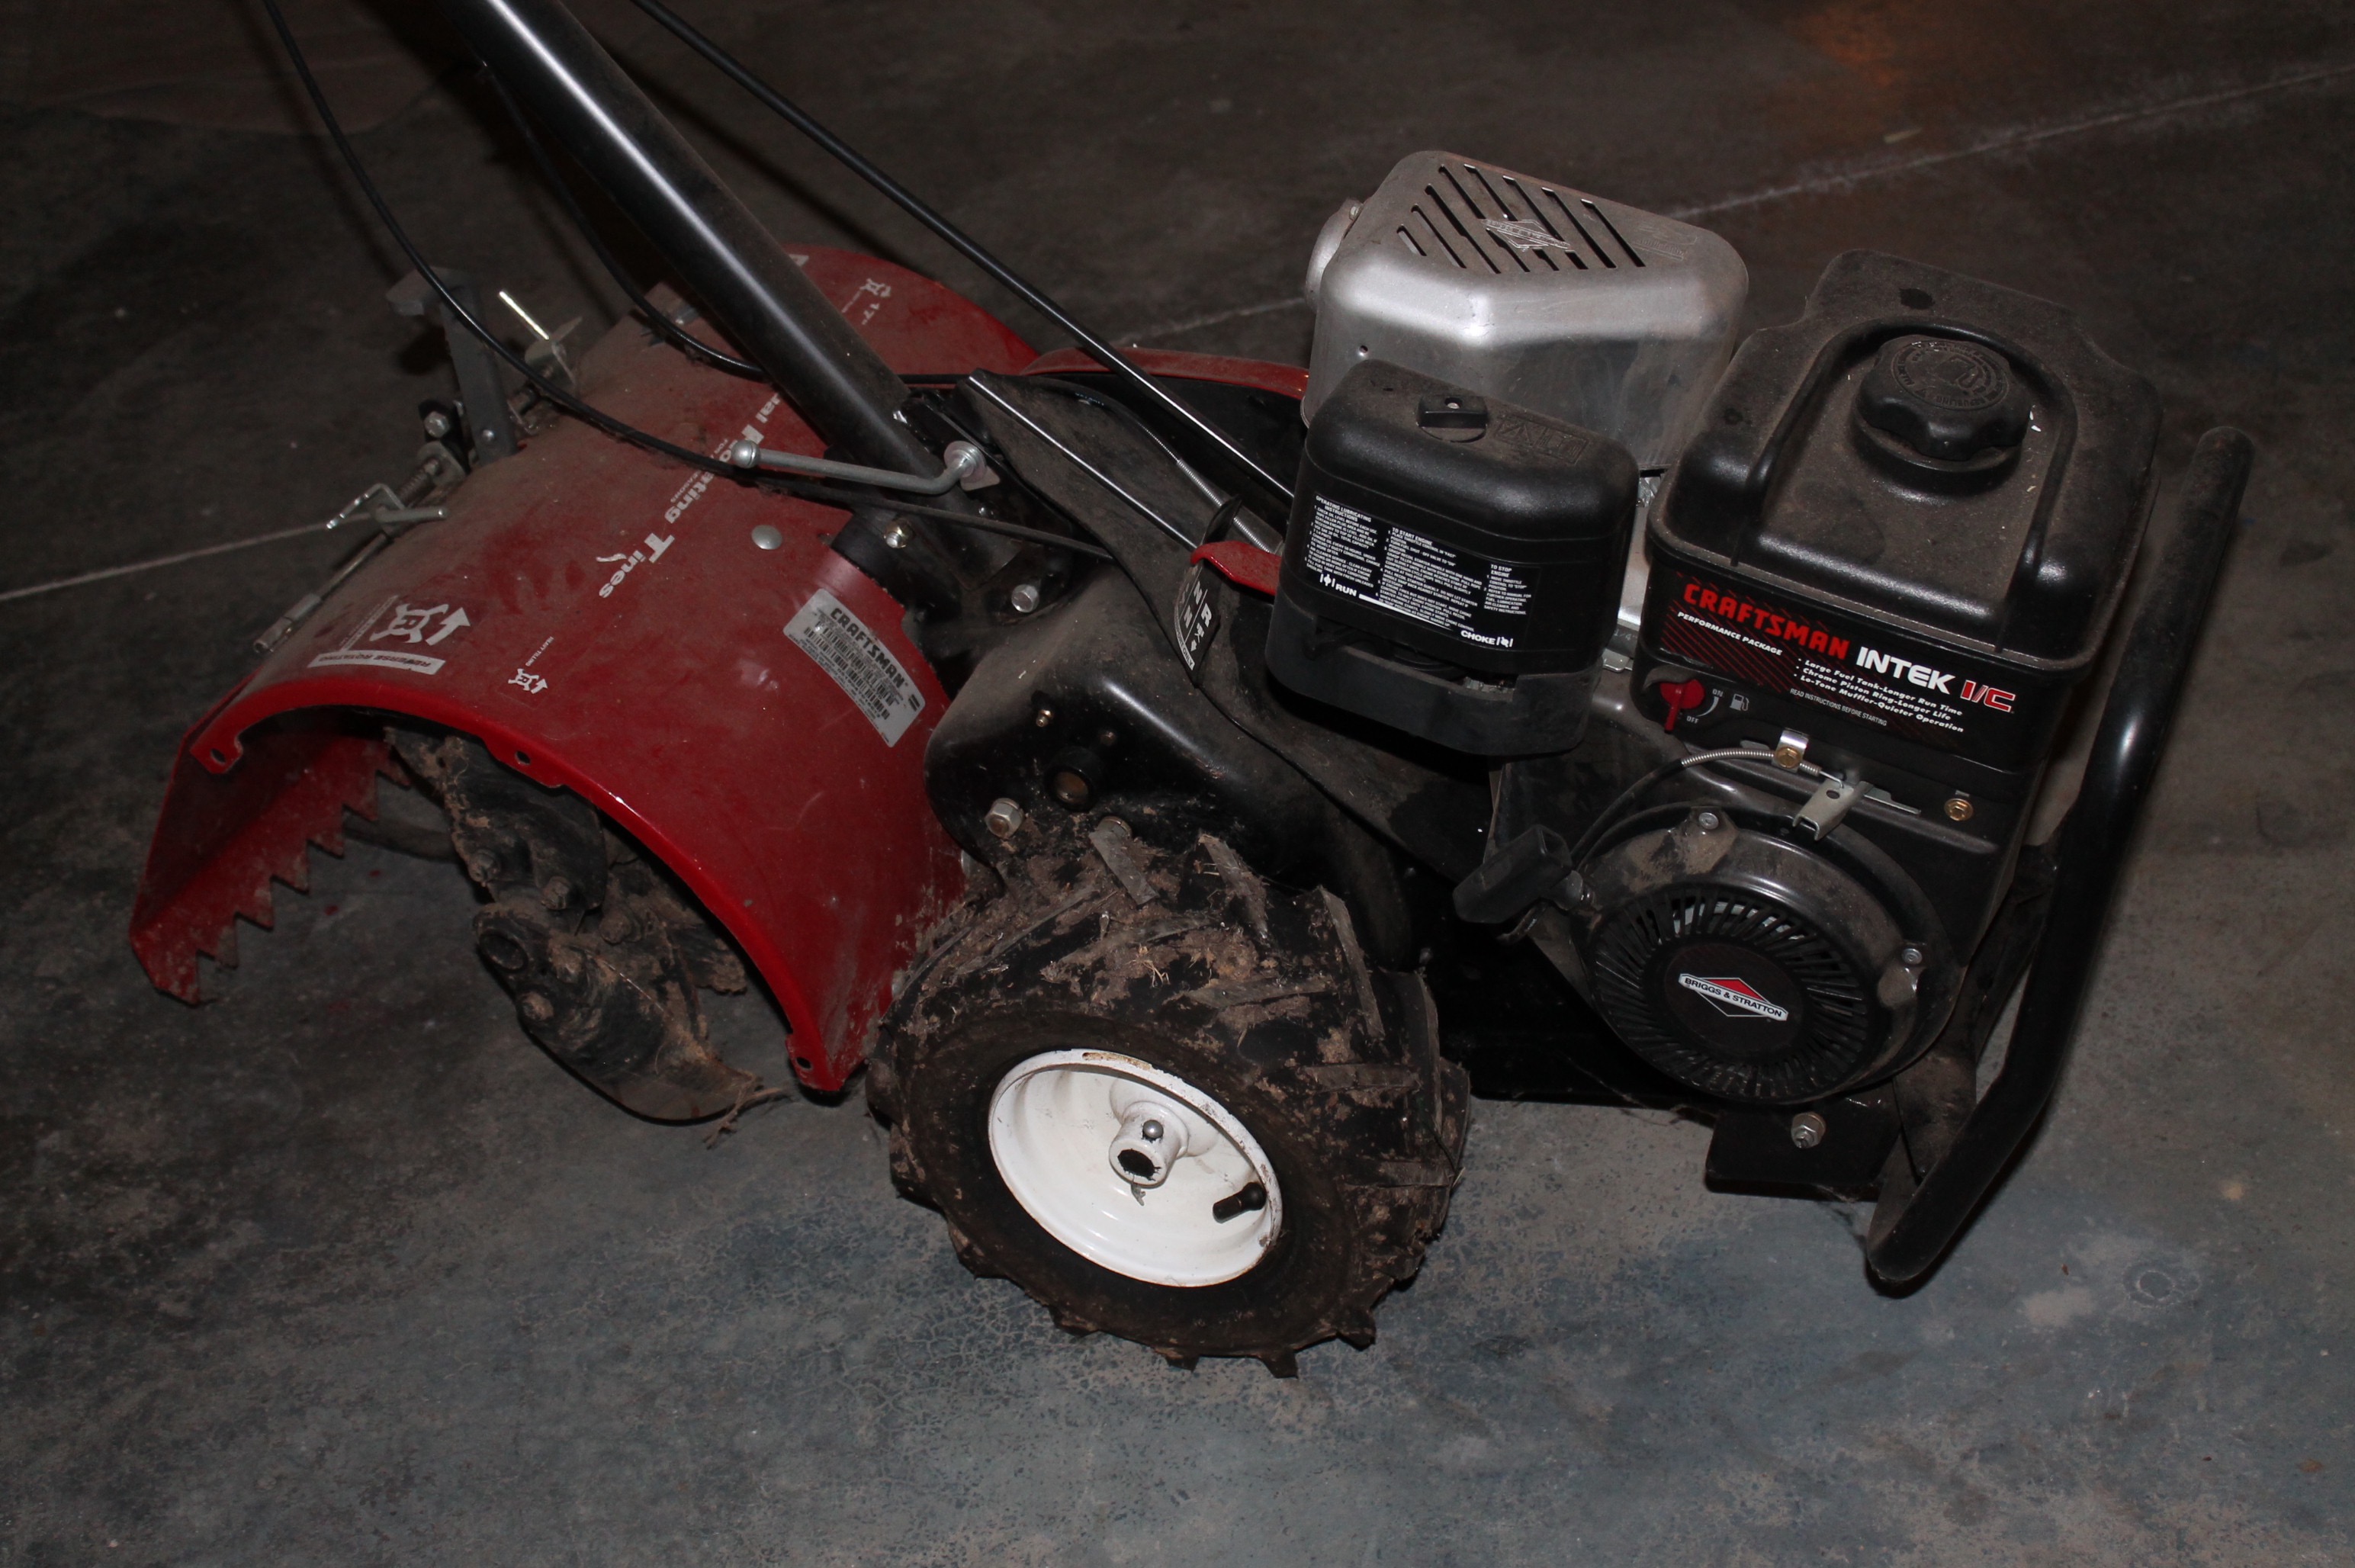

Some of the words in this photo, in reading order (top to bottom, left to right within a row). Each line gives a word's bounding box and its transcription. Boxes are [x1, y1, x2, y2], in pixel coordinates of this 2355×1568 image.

[1316, 496, 1341, 510] OPERATING
[1340, 507, 1372, 522] LUBRICATING
[1324, 506, 1358, 522] INSTRUCTIONS
[1399, 530, 1415, 539] START
[1415, 536, 1433, 545] ENGINE
[599, 533, 675, 599] Tines
[1335, 583, 1357, 596] RUN
[831, 608, 905, 689] CRAFTSMAN
[1460, 630, 1496, 645] CHOKE
[1677, 612, 1741, 641] PERFORMANCE
[1742, 636, 1782, 656] PACKAGE
[1683, 583, 1850, 660] CRAFTSMAN
[1855, 646, 1955, 695] INTEK
[1960, 680, 2016, 712] I/C
[1712, 688, 1723, 696] ON
[1801, 675, 1836, 692] Lo-Tone
[1839, 687, 1913, 719] Muffler-Quieter
[1916, 713, 1964, 733] Operation
[1803, 667, 1838, 685] Chrome
[1841, 680, 1870, 694] Piston
[1872, 690, 1931, 715] Ring-Longer
[1933, 708, 1951, 721] Life
[1804, 660, 1831, 675] Large
[1834, 668, 1855, 681] Fuel
[1857, 676, 1916, 702] Tank-Longer
[1918, 696, 1937, 709] Run
[1940, 702, 1962, 716] Time
[1686, 715, 1698, 724] OFF
[1791, 689, 1804, 697] READ
[1804, 692, 1841, 710] INSTRUCTIONS
[1842, 704, 1861, 718] BEFORE
[1862, 712, 1887, 726] STARTING
[1685, 978, 1721, 995] BRIGGS
[1733, 994, 1782, 1017] STRATTON
